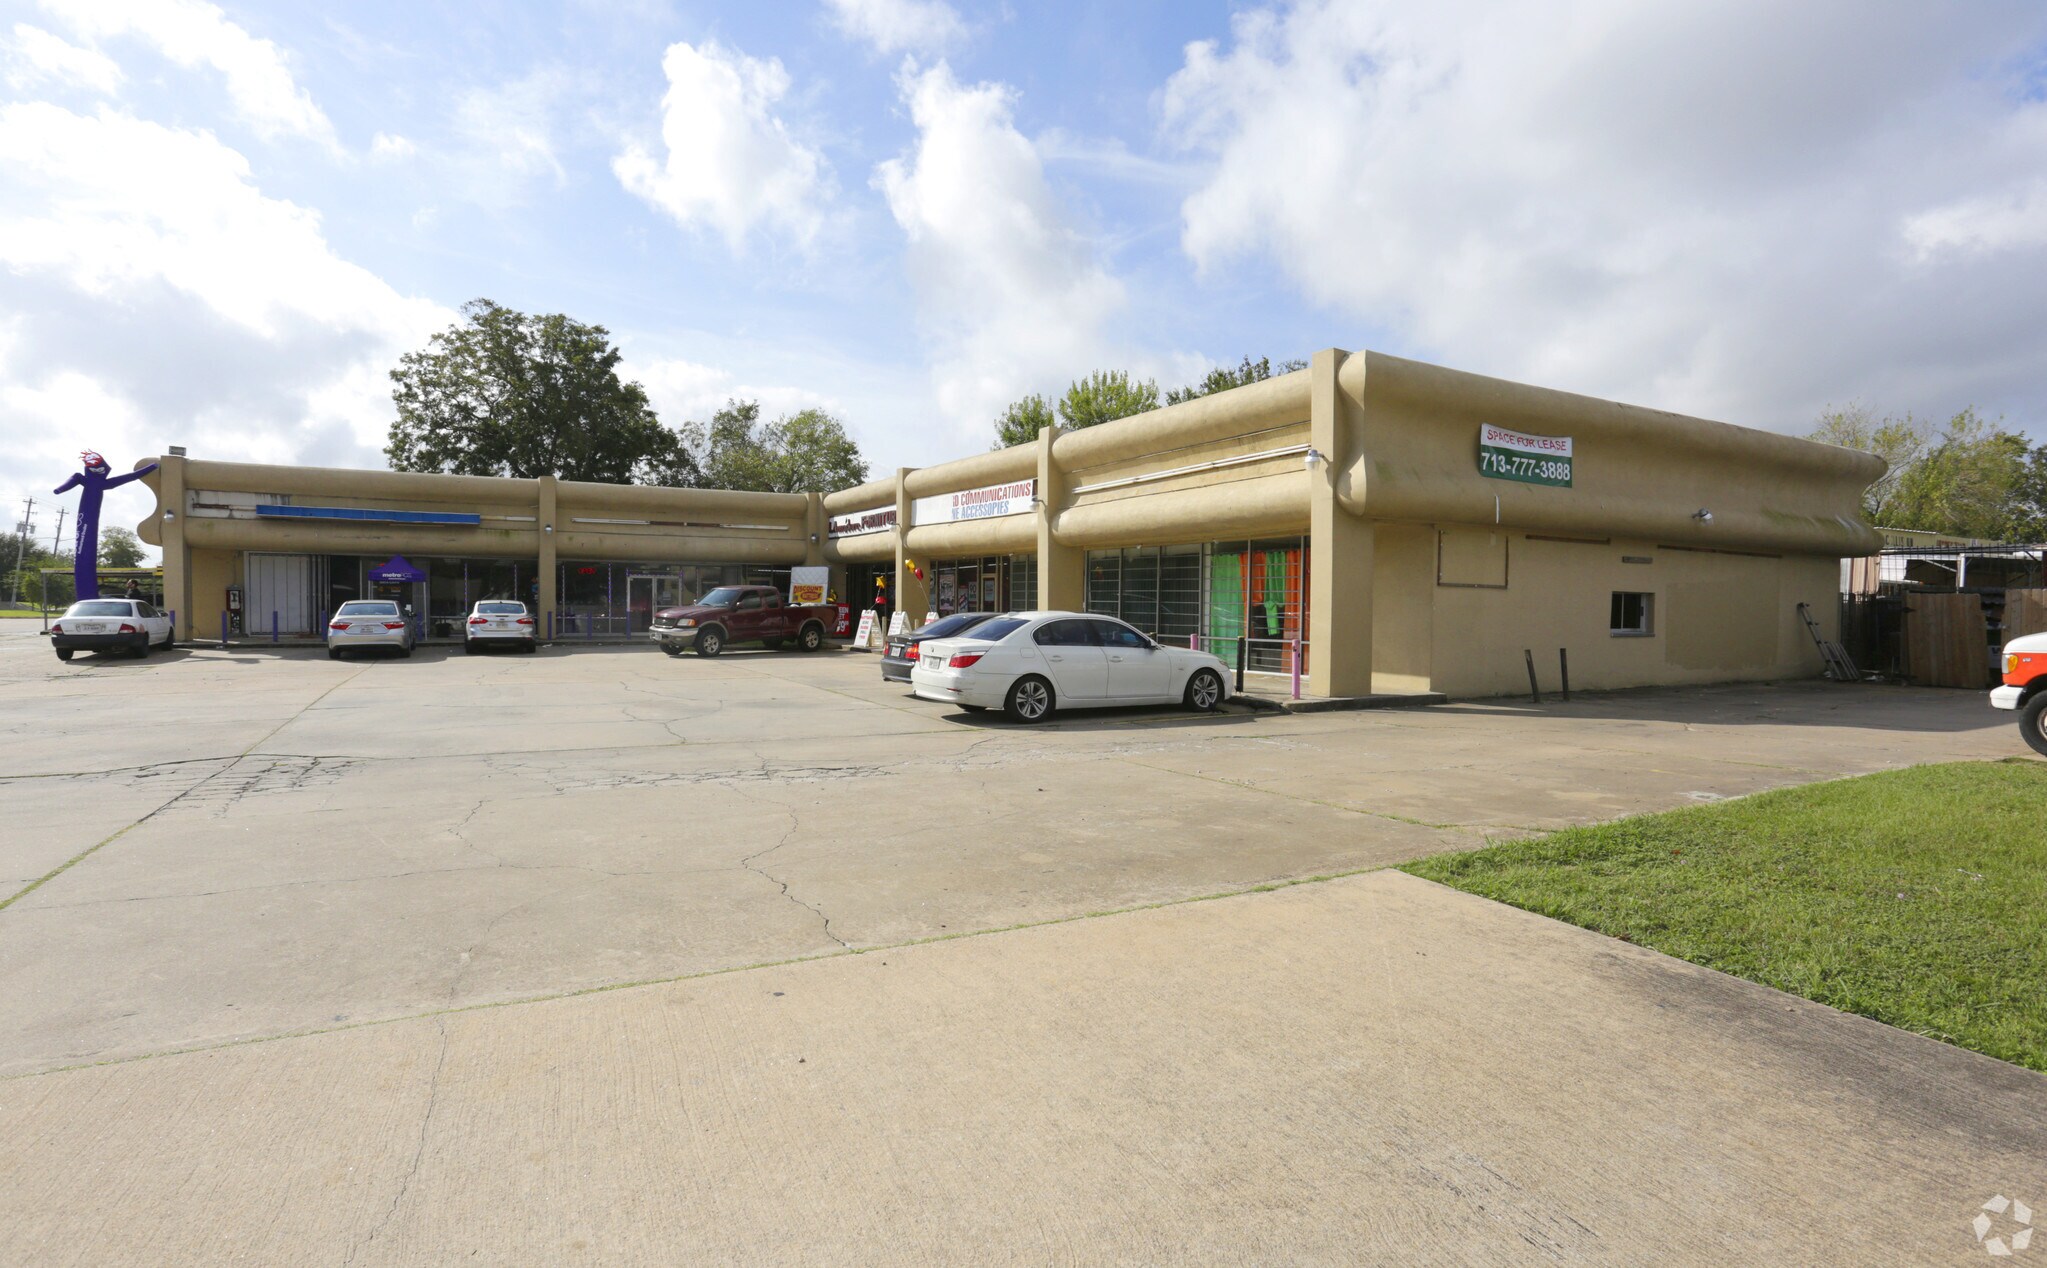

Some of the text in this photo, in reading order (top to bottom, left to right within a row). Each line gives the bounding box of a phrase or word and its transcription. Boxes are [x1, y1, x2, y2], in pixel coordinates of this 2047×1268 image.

[1487, 429, 1567, 451] SPACE FOR LEASE
[1481, 452, 1570, 481] 713-777-3888
[961, 482, 1031, 506] COMMUNICATIONS
[793, 585, 823, 594] DISCOUNT
